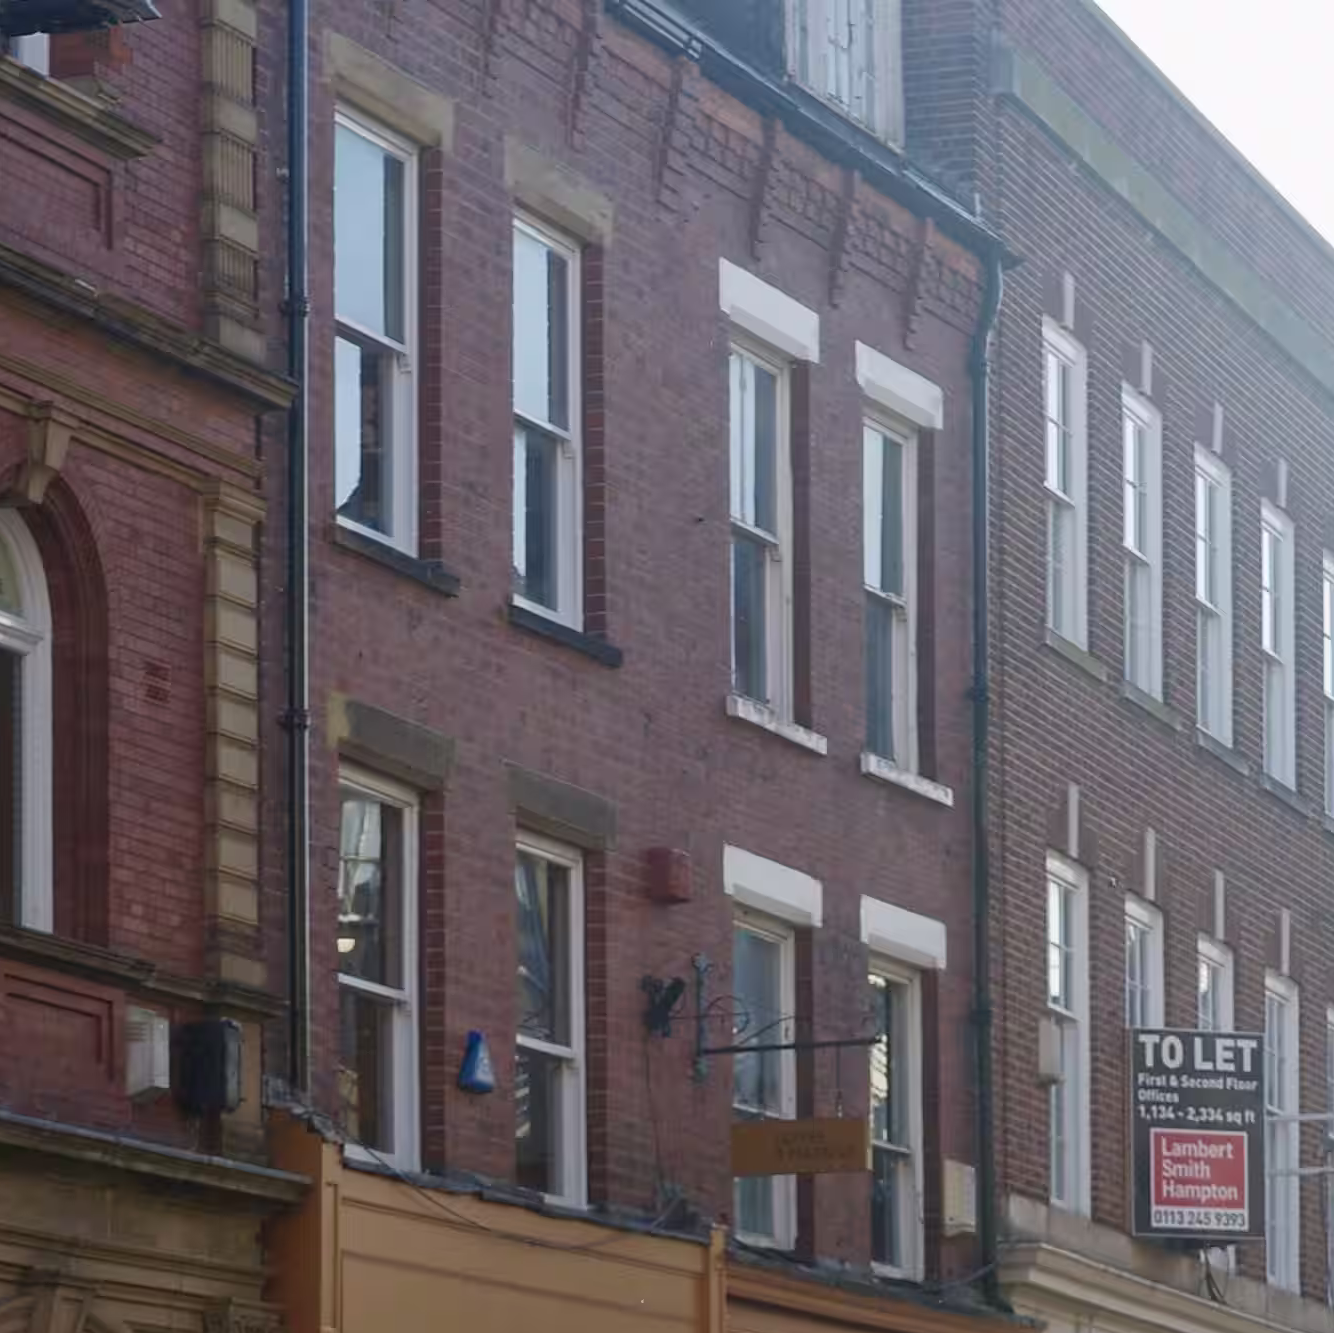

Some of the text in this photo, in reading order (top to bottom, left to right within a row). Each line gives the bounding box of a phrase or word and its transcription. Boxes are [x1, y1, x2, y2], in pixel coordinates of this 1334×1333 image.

[1138, 1033, 1258, 1072] TO LET
[1137, 1072, 1167, 1087] First
[1180, 1074, 1224, 1089] Second
[1226, 1076, 1258, 1091] Floor
[1137, 1087, 1180, 1103] Offices
[1226, 1110, 1243, 1126] sq
[1161, 1136, 1234, 1159] Lambert
[1161, 1158, 1211, 1178] Smith
[1162, 1179, 1239, 1205] Hampton
[1154, 1209, 1185, 1225] 0113
